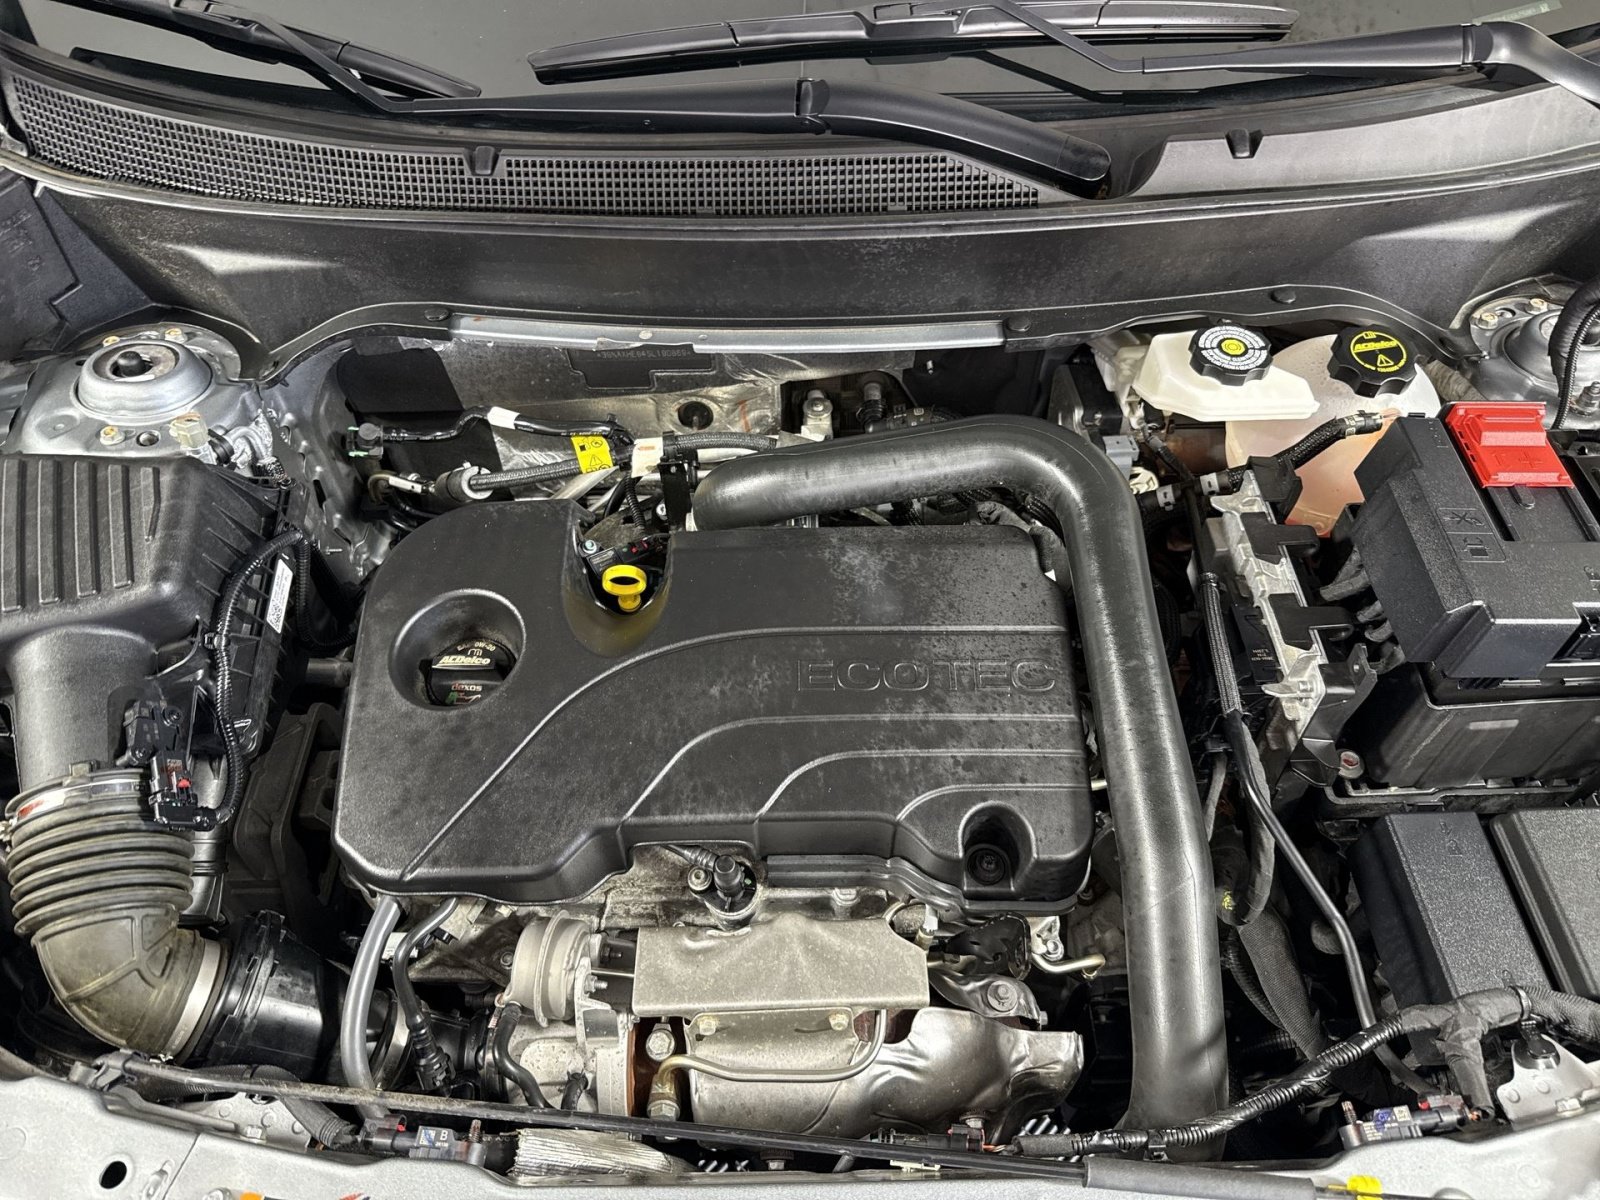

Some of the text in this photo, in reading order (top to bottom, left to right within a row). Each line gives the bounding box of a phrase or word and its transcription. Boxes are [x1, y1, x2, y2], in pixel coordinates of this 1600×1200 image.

[474, 641, 496, 652] 0W-20
[437, 655, 491, 666] ACDelco
[797, 657, 1056, 692] ECOTEC
[451, 682, 483, 692] dexos
[439, 1129, 449, 1141] B
